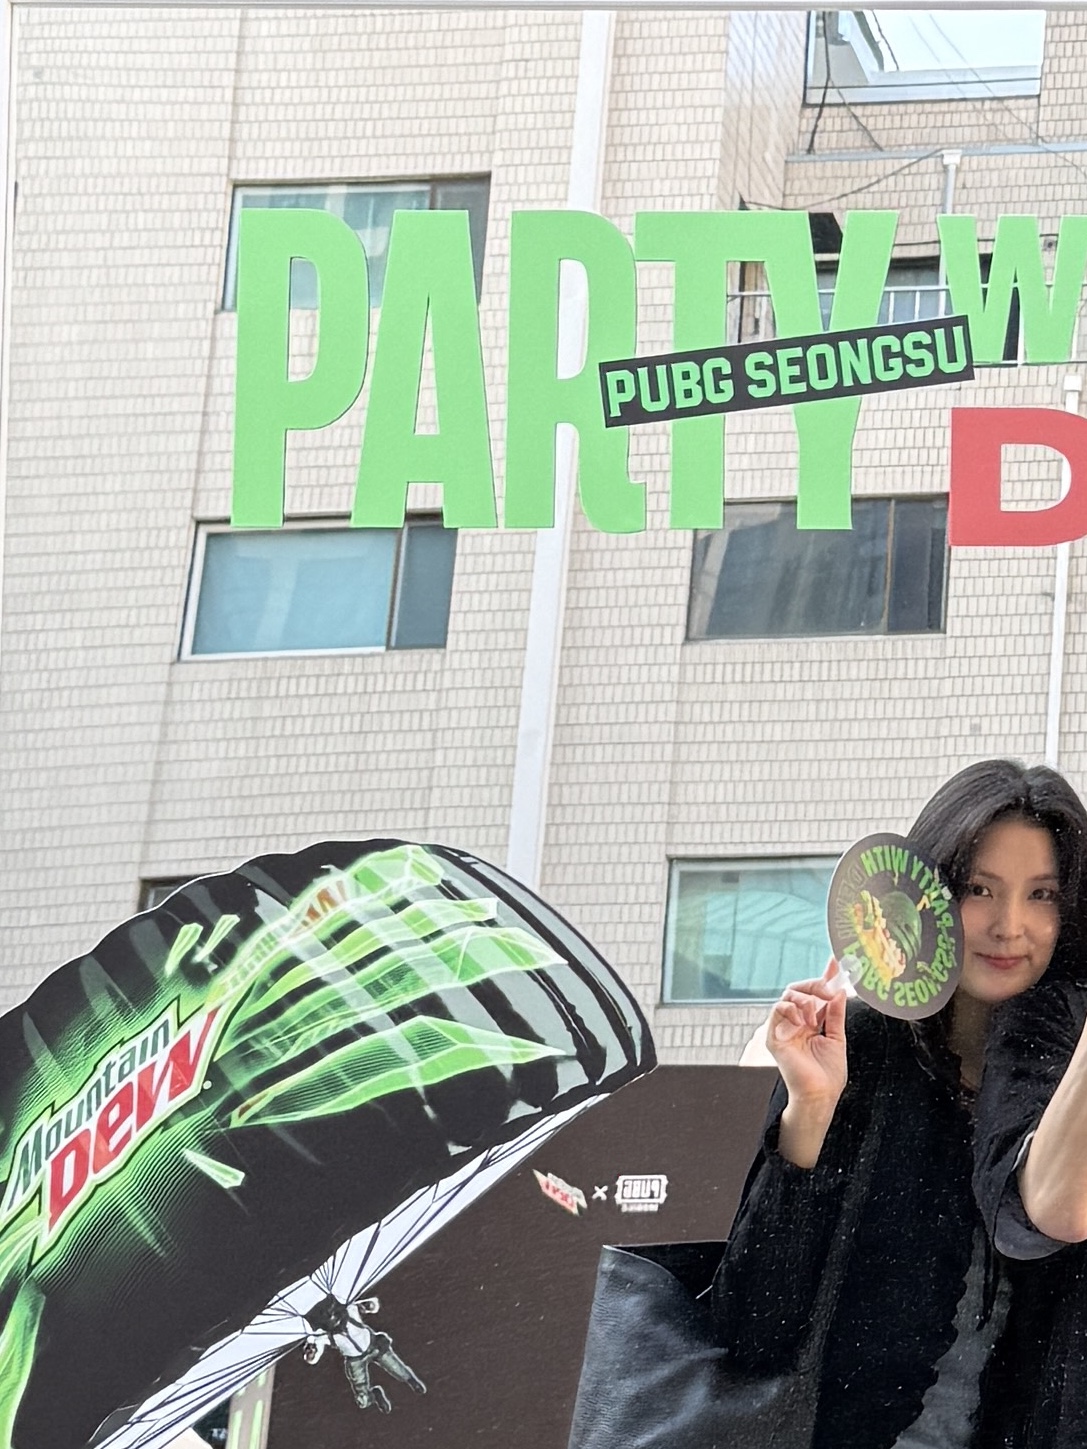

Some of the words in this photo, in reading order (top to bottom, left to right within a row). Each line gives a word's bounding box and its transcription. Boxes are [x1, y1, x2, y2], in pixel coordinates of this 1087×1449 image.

[231, 209, 898, 534] PARTY
[606, 356, 735, 418] PUBG
[745, 325, 968, 399] SEONGSU
[6, 1018, 170, 1212] Mountain
